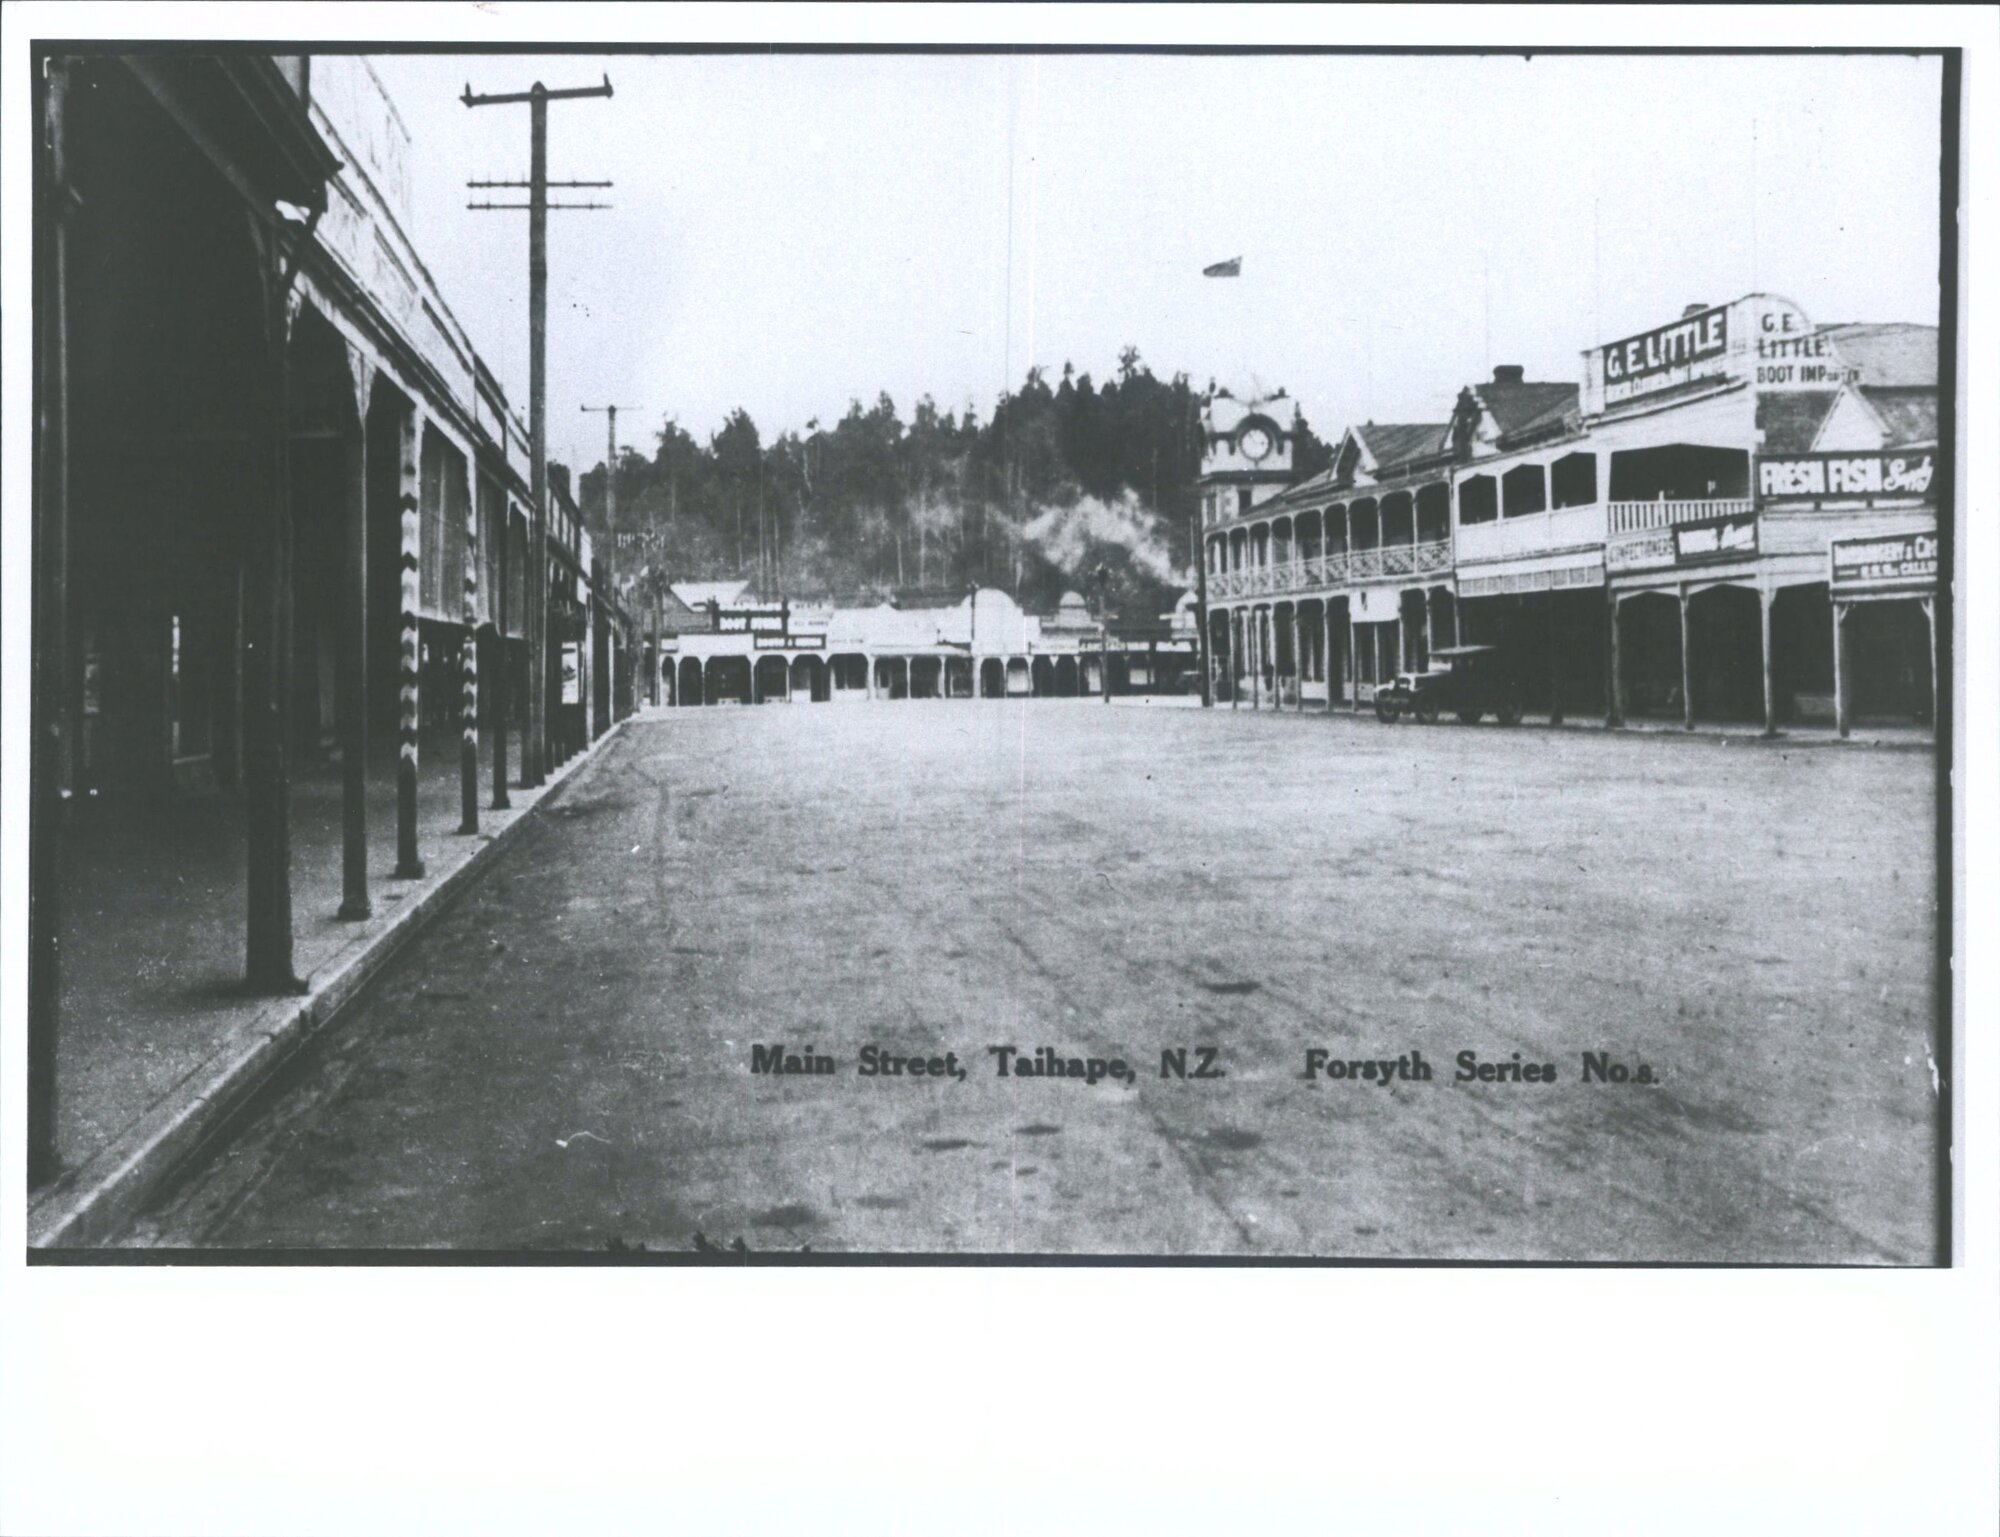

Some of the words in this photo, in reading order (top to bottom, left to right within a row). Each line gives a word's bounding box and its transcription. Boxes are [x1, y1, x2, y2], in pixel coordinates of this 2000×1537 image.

[1646, 313, 1723, 368] LITTLE
[1757, 364, 1794, 384] BOOT
[1760, 460, 1825, 495] FRESH
[1828, 458, 1882, 493] FISH
